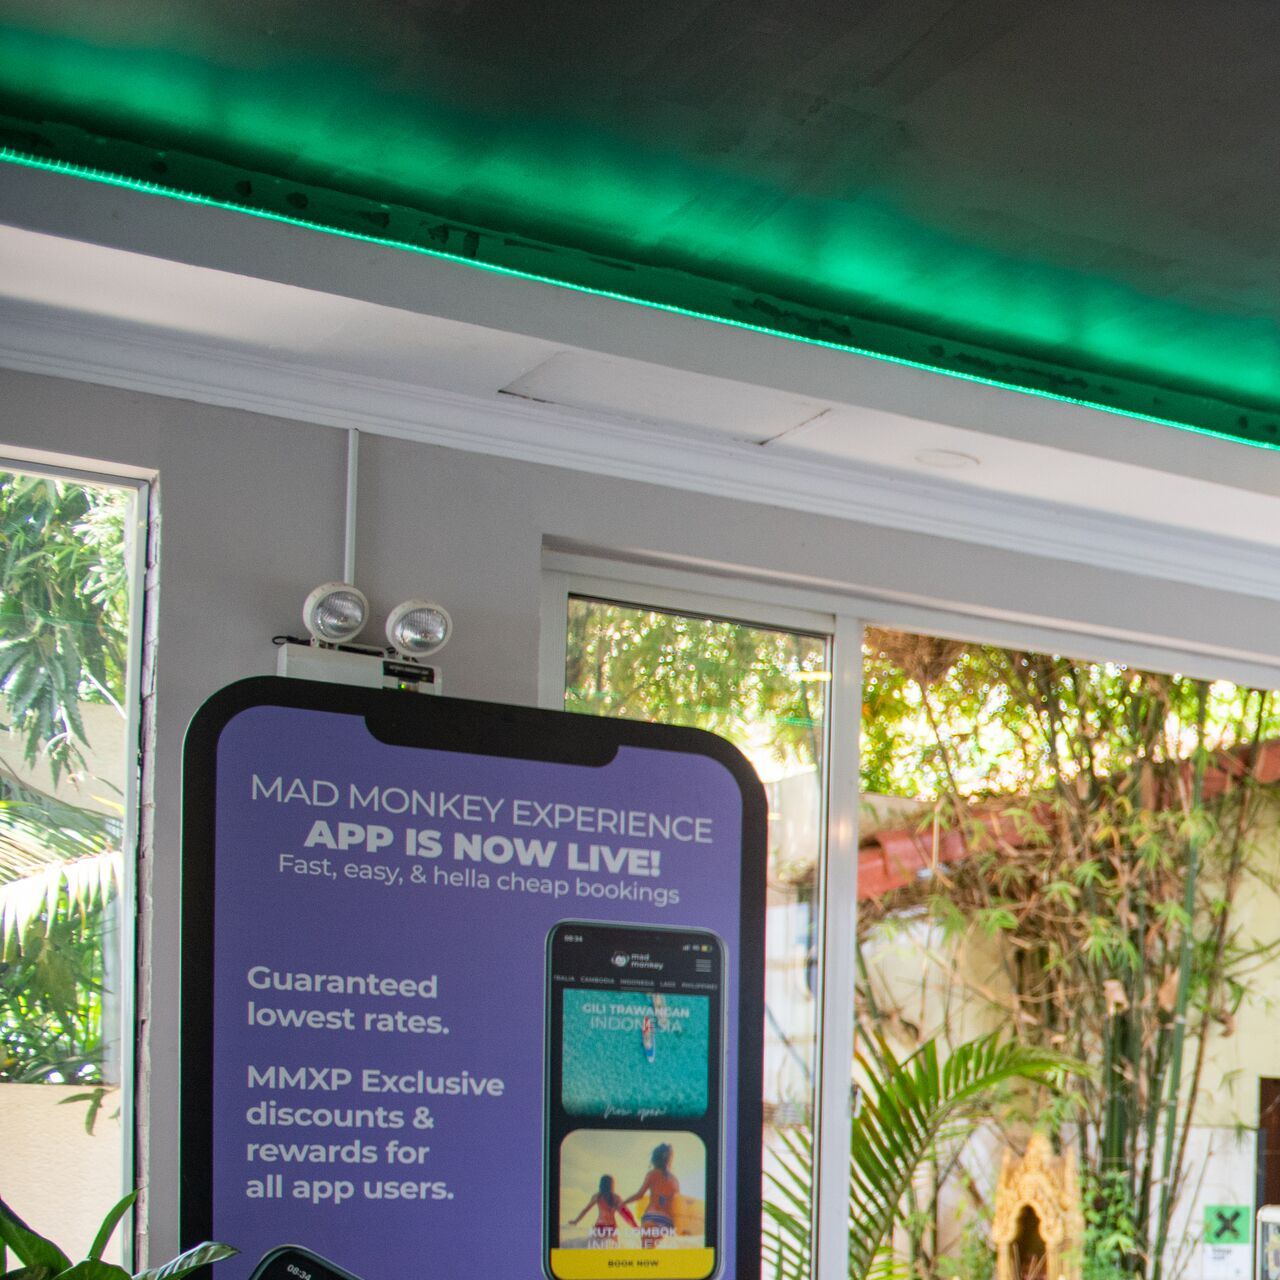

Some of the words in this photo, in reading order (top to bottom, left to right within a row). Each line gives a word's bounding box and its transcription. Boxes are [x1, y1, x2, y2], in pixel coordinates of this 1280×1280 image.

[250, 774, 339, 806] MAD
[349, 783, 504, 822] MONKEY
[512, 800, 713, 843] EXPERIENCE
[304, 820, 394, 852] APP
[406, 829, 442, 857] IS
[454, 832, 556, 866] NOW
[568, 844, 661, 877] LIVE!
[278, 854, 337, 879] Fast,
[343, 862, 404, 886] easy,
[410, 866, 427, 883] &
[433, 868, 490, 889] hella
[497, 872, 570, 898] cheap
[576, 878, 680, 907] bookings
[247, 966, 438, 998] Guaranteed
[247, 1001, 355, 1029] lowest
[364, 1012, 450, 1035] rates.
[582, 1004, 605, 1013] GILI
[609, 1005, 689, 1018] TRAWANGAN
[247, 1066, 352, 1090] MMXP
[361, 1070, 504, 1096] Exclusive
[246, 1102, 404, 1129] discounts
[413, 1106, 434, 1129] &
[246, 1140, 378, 1164] rewards
[386, 1138, 428, 1164] for
[246, 1176, 284, 1199] all
[293, 1181, 354, 1204] app
[363, 1178, 454, 1200] users.
